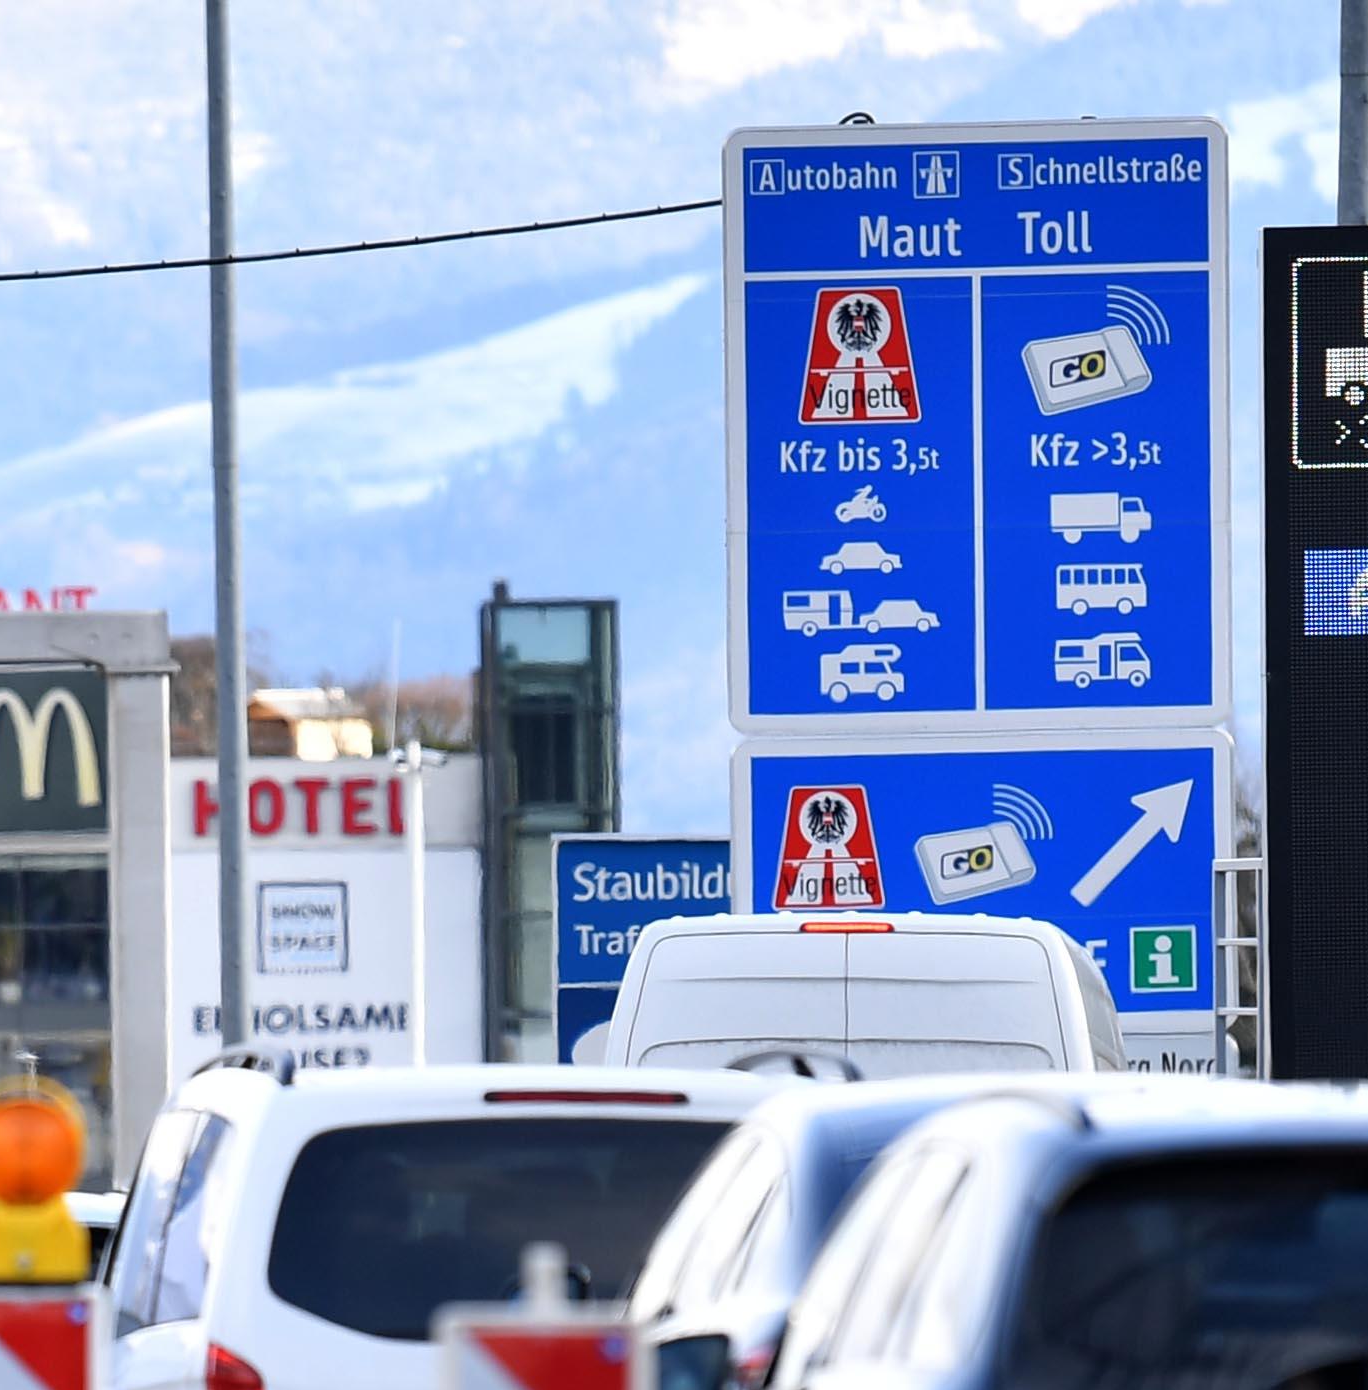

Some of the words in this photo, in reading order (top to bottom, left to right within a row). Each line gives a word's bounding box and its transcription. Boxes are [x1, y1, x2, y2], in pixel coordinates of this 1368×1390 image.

[753, 160, 898, 194] Autobahn
[1001, 154, 1202, 188] Schnellstraße
[858, 215, 962, 258] Maut
[1017, 211, 1093, 254] Toll
[1060, 353, 1106, 382] GO
[810, 382, 913, 415] Vignette
[779, 440, 827, 473] Kfz
[838, 440, 881, 472] bis
[891, 439, 940, 475] 3,5t
[1030, 434, 1080, 467] Kfz
[951, 844, 993, 874] GO
[573, 861, 731, 902] Staubild
[783, 870, 876, 902] Vignette
